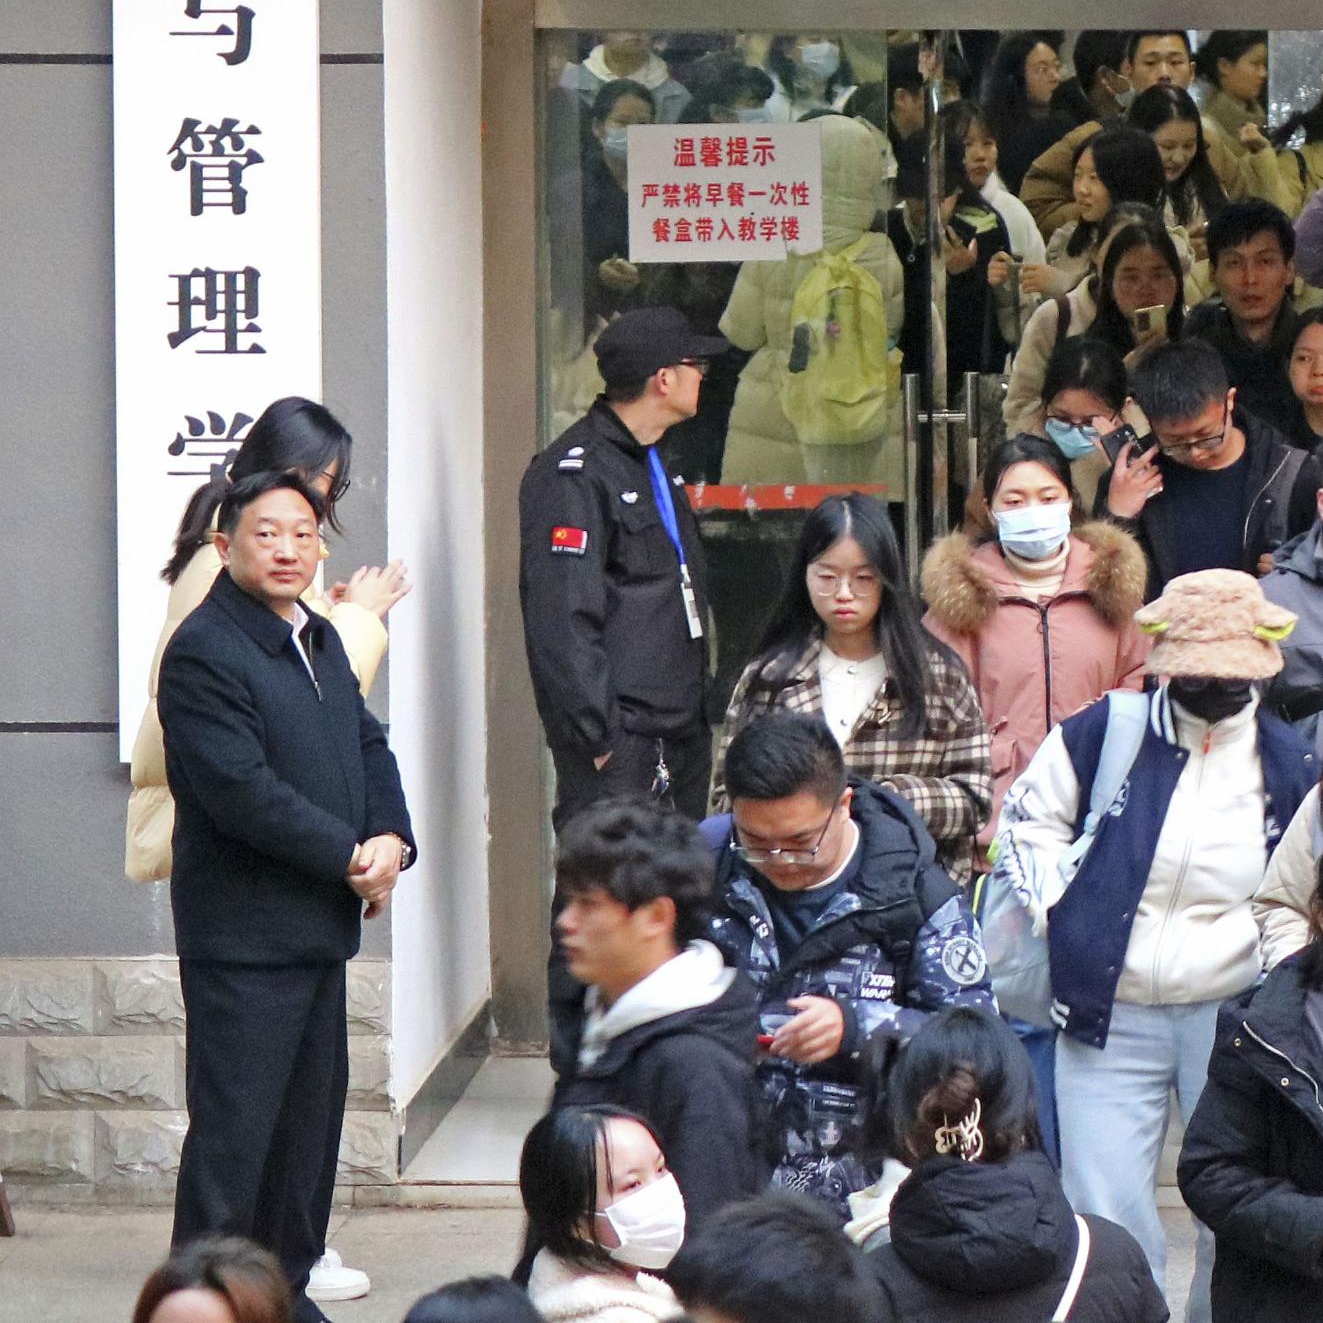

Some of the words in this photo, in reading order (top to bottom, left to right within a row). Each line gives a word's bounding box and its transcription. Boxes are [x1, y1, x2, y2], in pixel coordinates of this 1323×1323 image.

[673, 136, 776, 168] 温馨提示
[641, 181, 811, 209] 严禁将早餐一次性
[652, 215, 800, 244] 餐盒带入教学楼
